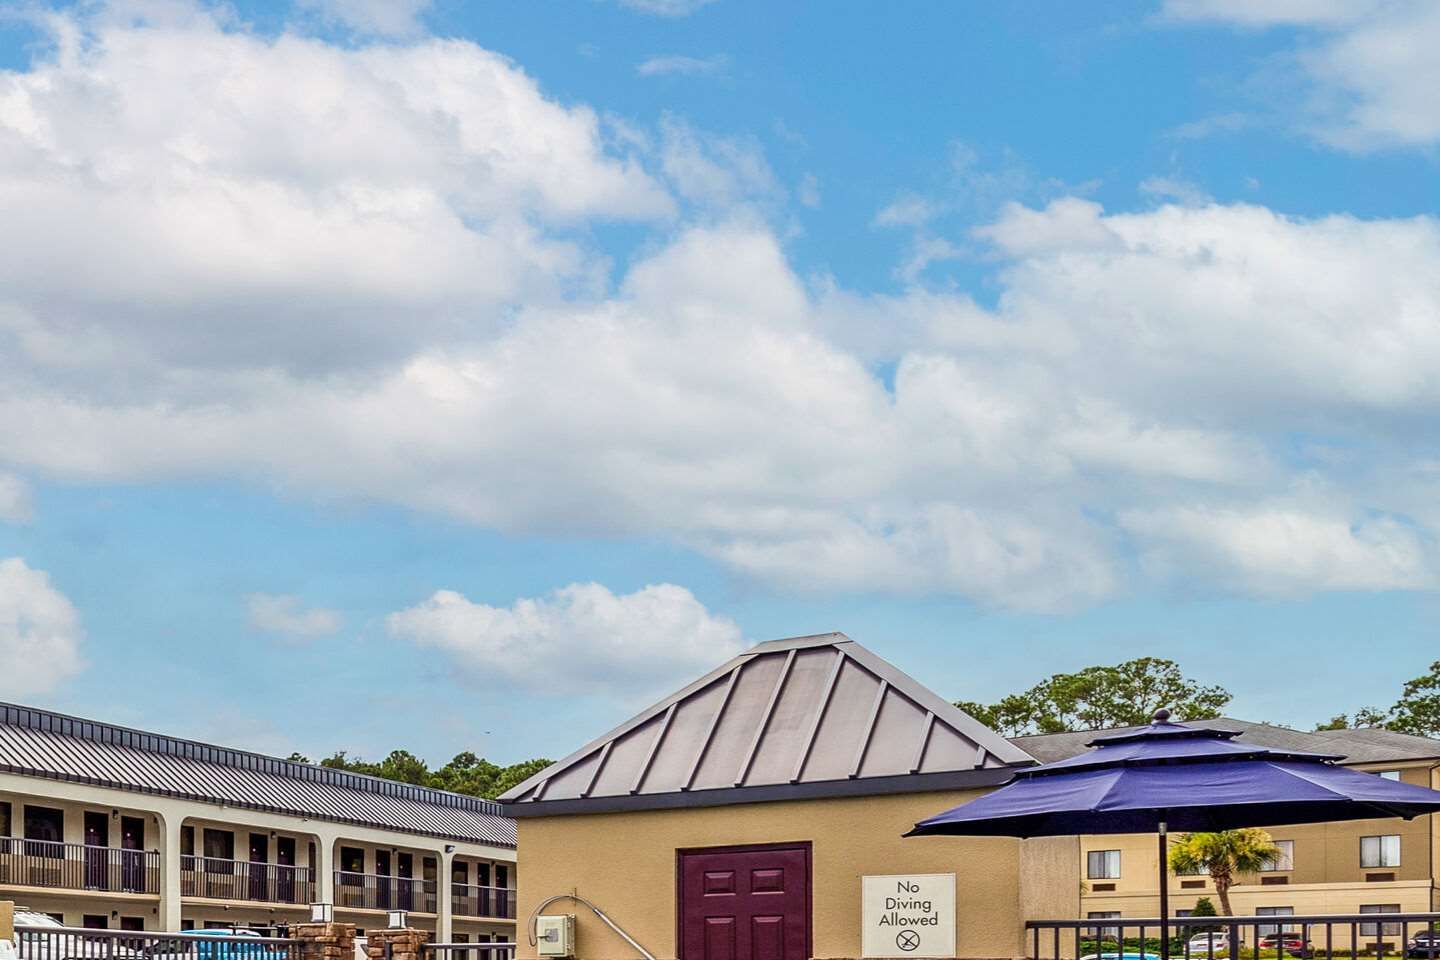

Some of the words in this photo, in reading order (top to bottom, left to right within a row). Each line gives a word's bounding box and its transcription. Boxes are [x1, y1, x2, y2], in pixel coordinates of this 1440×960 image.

[897, 881, 920, 894] No
[885, 897, 932, 913] Diving
[878, 911, 939, 927] Allowed
